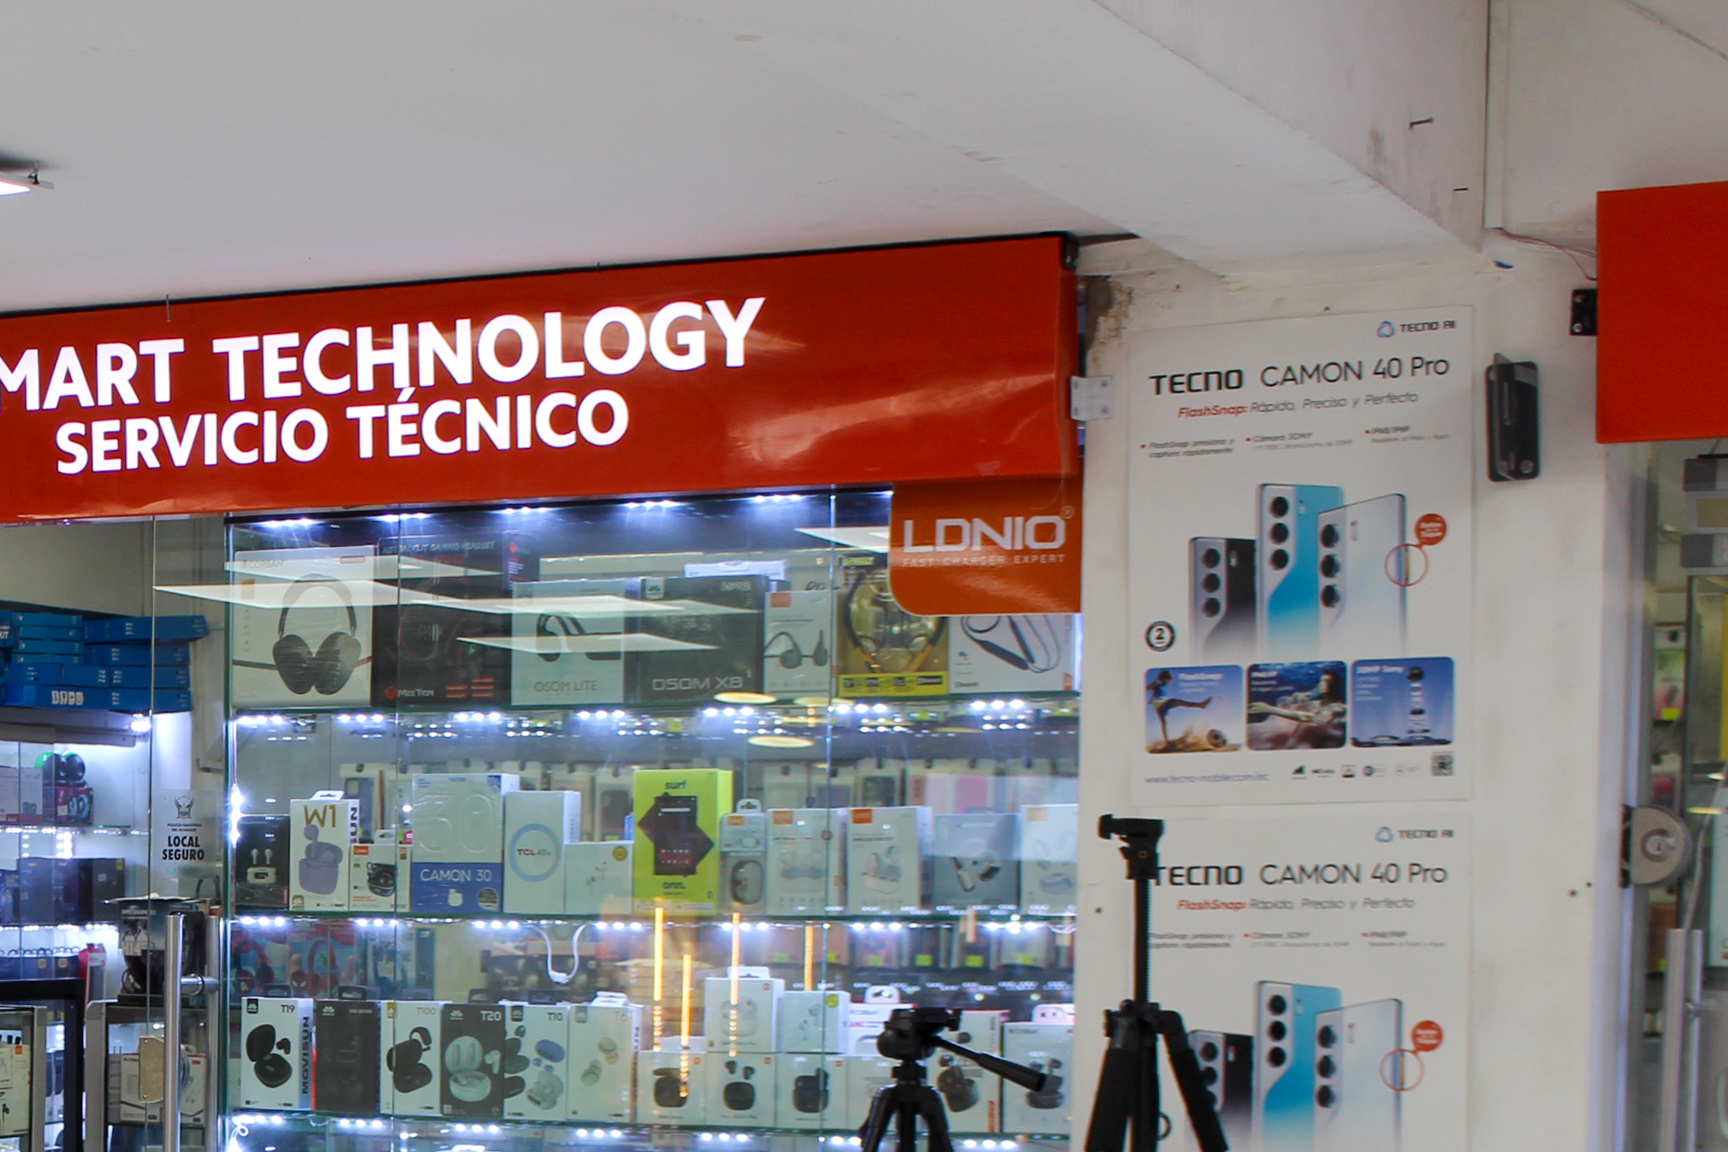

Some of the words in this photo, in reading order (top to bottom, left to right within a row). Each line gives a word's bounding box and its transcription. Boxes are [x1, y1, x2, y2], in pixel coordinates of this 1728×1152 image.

[212, 296, 766, 402] TECHNOLOGY
[1149, 368, 1244, 395] TECNO
[1260, 360, 1363, 387] CAMON
[1371, 356, 1402, 379] 40
[1410, 356, 1450, 377] Pro
[56, 408, 330, 475] SERVICIO
[345, 388, 630, 460] TÉCNICO
[903, 515, 1066, 554] LDNIO
[461, 541, 495, 551] HEADSET
[902, 556, 934, 567] FAST
[943, 554, 1006, 566] CHARGER
[1013, 552, 1066, 564] EXPERT
[665, 780, 687, 790] surf
[303, 804, 337, 828] W1
[167, 836, 200, 847] LOCAL
[162, 849, 205, 860] SEGURO
[420, 869, 471, 881] CAMON
[475, 869, 492, 881] 30
[1154, 865, 1243, 886] TECNO
[1259, 864, 1361, 885] CAMON
[1370, 863, 1400, 884] 40
[1408, 863, 1448, 884] Pro
[281, 1004, 296, 1014] T19
[480, 1010, 503, 1021] T20
[301, 1016, 310, 1095] MOVISUN
